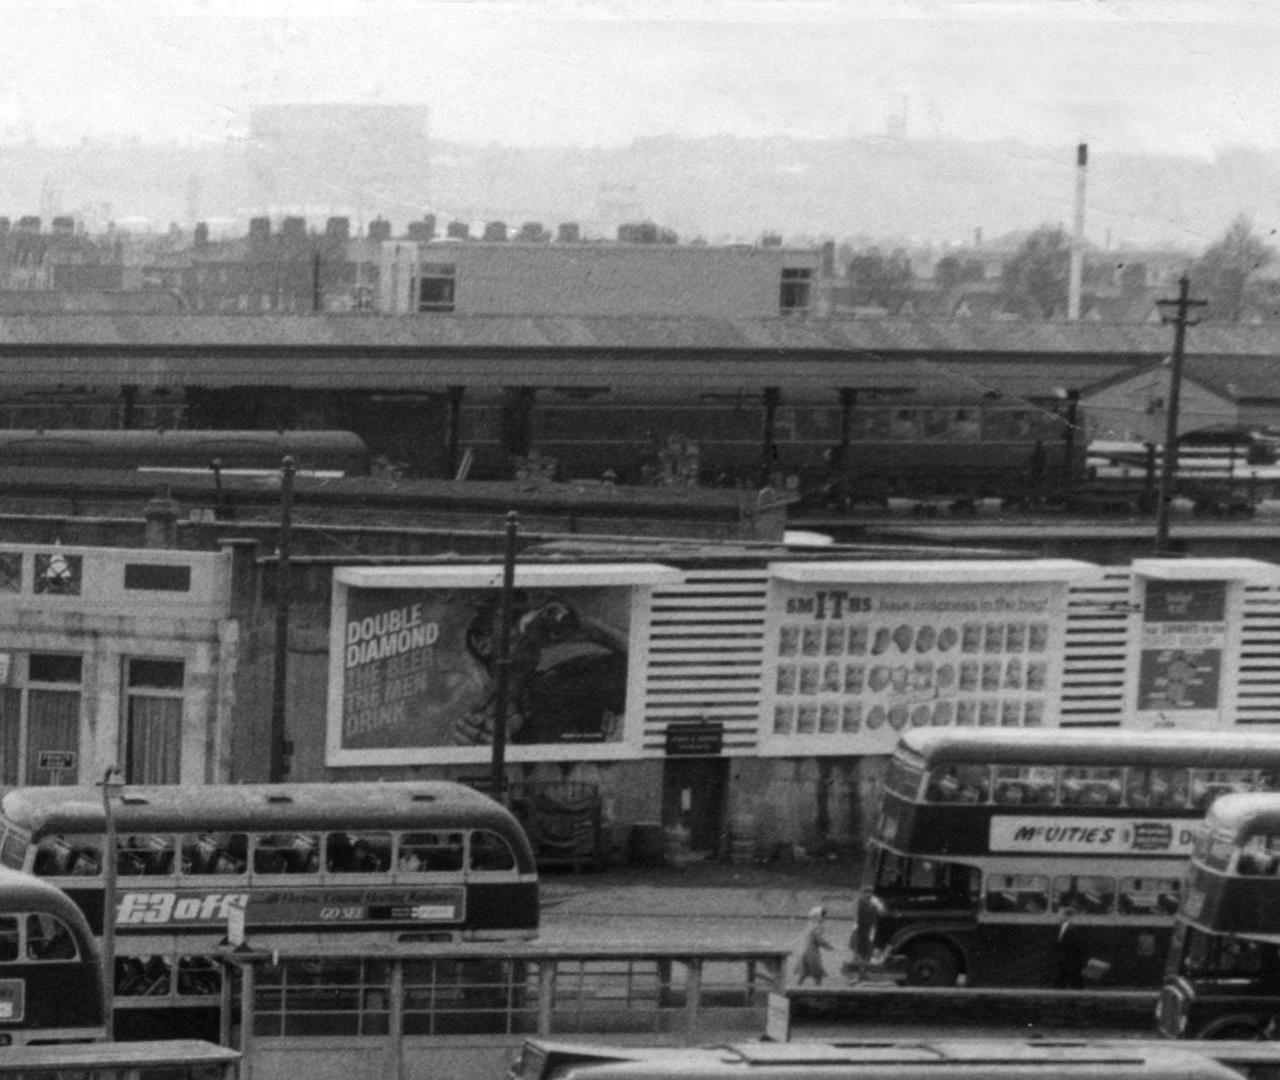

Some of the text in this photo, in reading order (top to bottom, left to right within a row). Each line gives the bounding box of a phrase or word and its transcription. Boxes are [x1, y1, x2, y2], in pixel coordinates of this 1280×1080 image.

[785, 591, 873, 620] SMITHS
[347, 603, 422, 645] DOUBLE
[345, 622, 440, 668] DIAMOND
[346, 701, 406, 738] DRINK
[115, 892, 177, 924] £3
[319, 906, 366, 920] GO SEE
